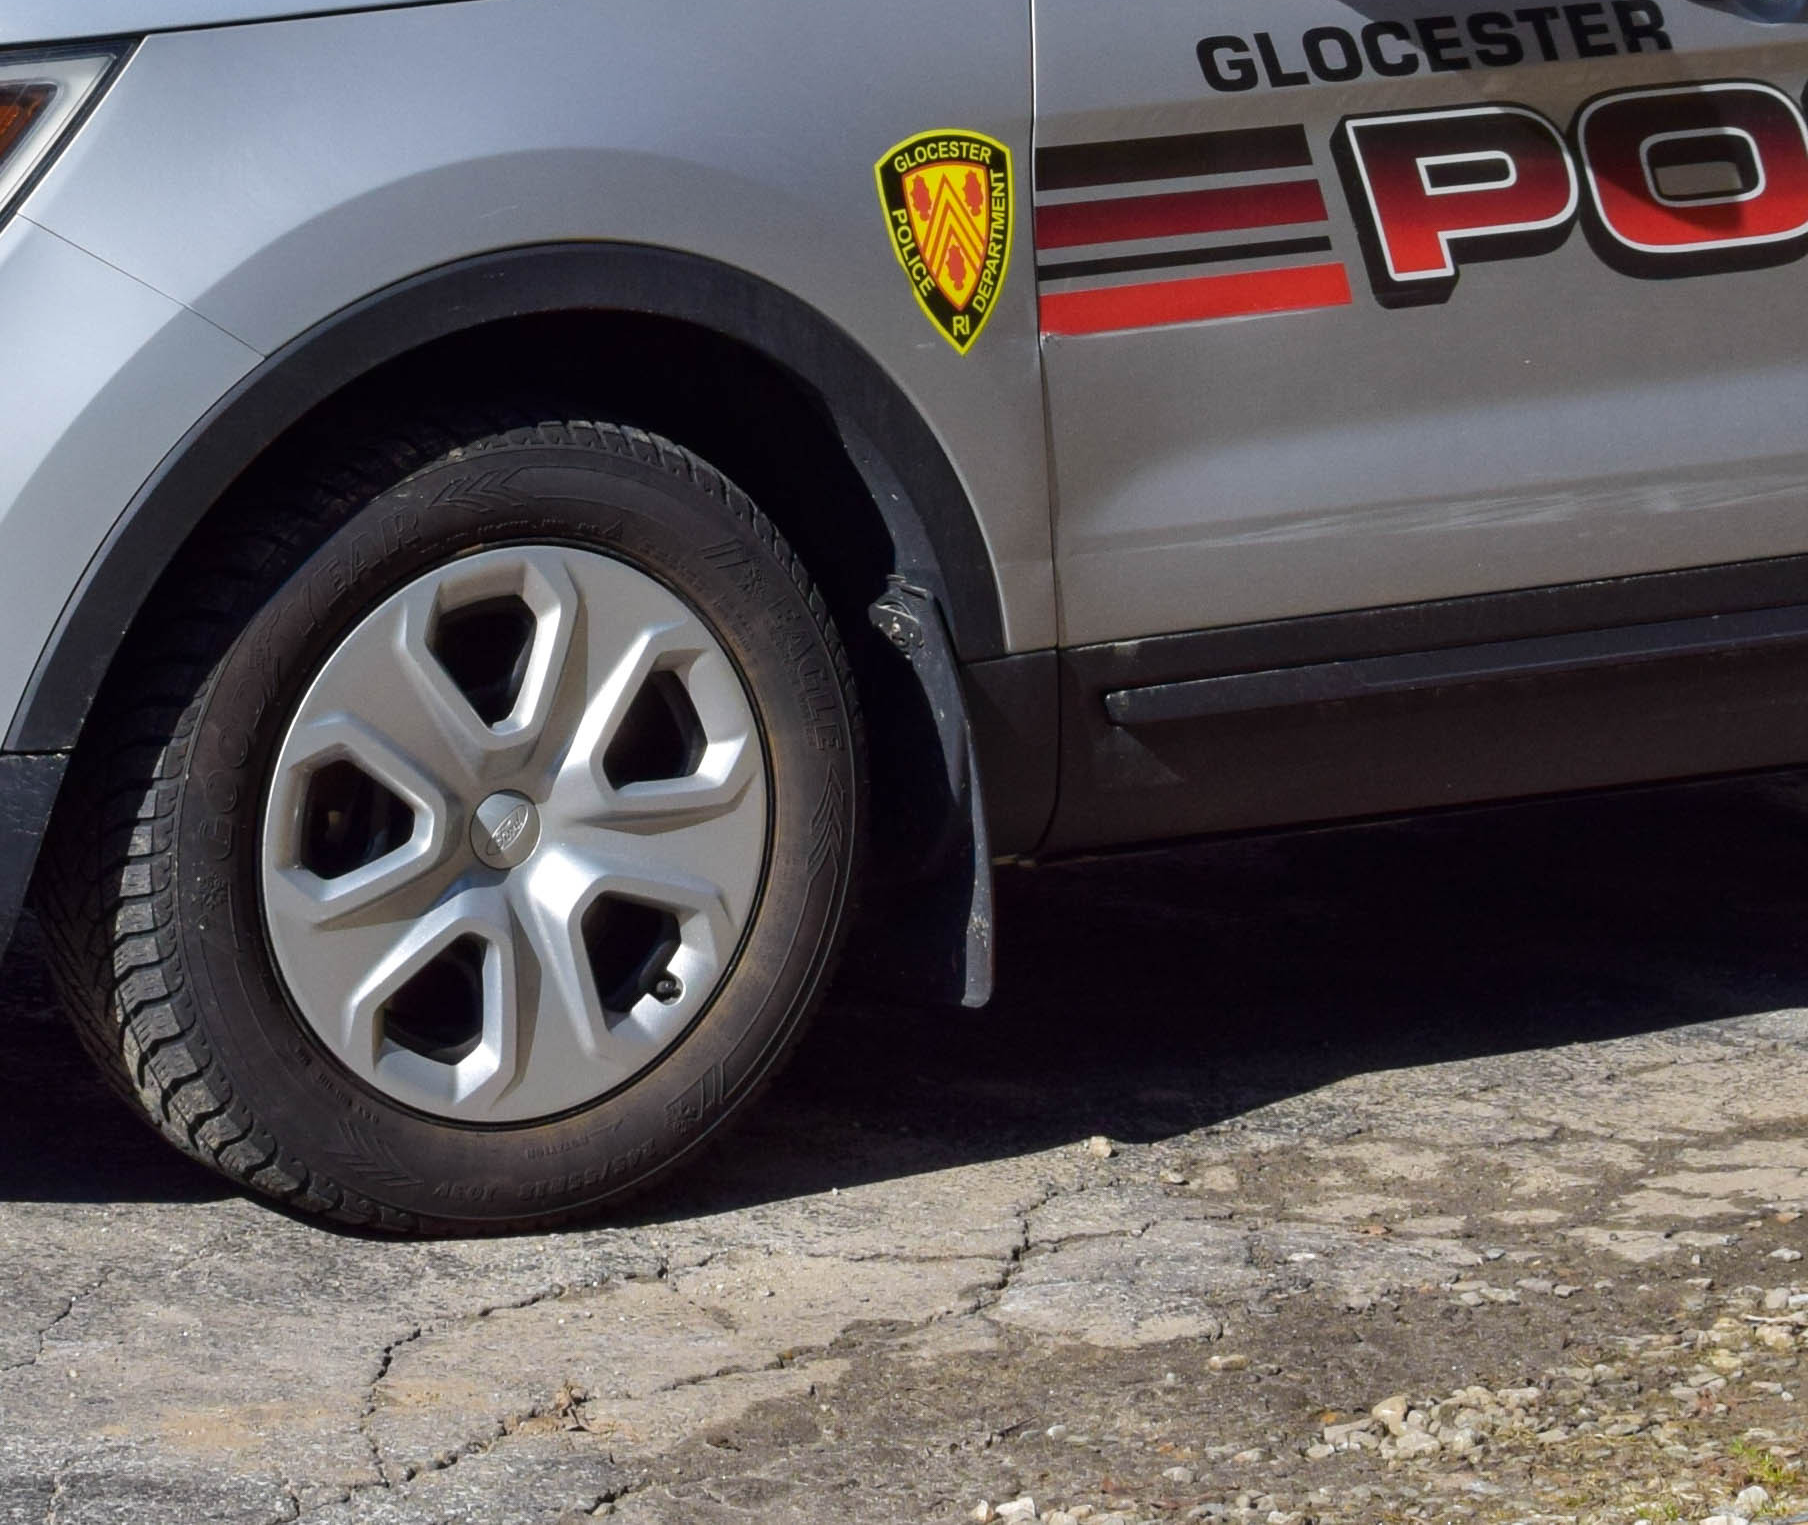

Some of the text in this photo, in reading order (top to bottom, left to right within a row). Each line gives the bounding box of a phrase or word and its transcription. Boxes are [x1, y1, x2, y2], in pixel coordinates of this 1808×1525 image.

[894, 139, 992, 174] GLOCESTER
[891, 210, 936, 298] POLICE
[972, 169, 1005, 314] DEPARTMENT
[952, 315, 970, 337] RI
